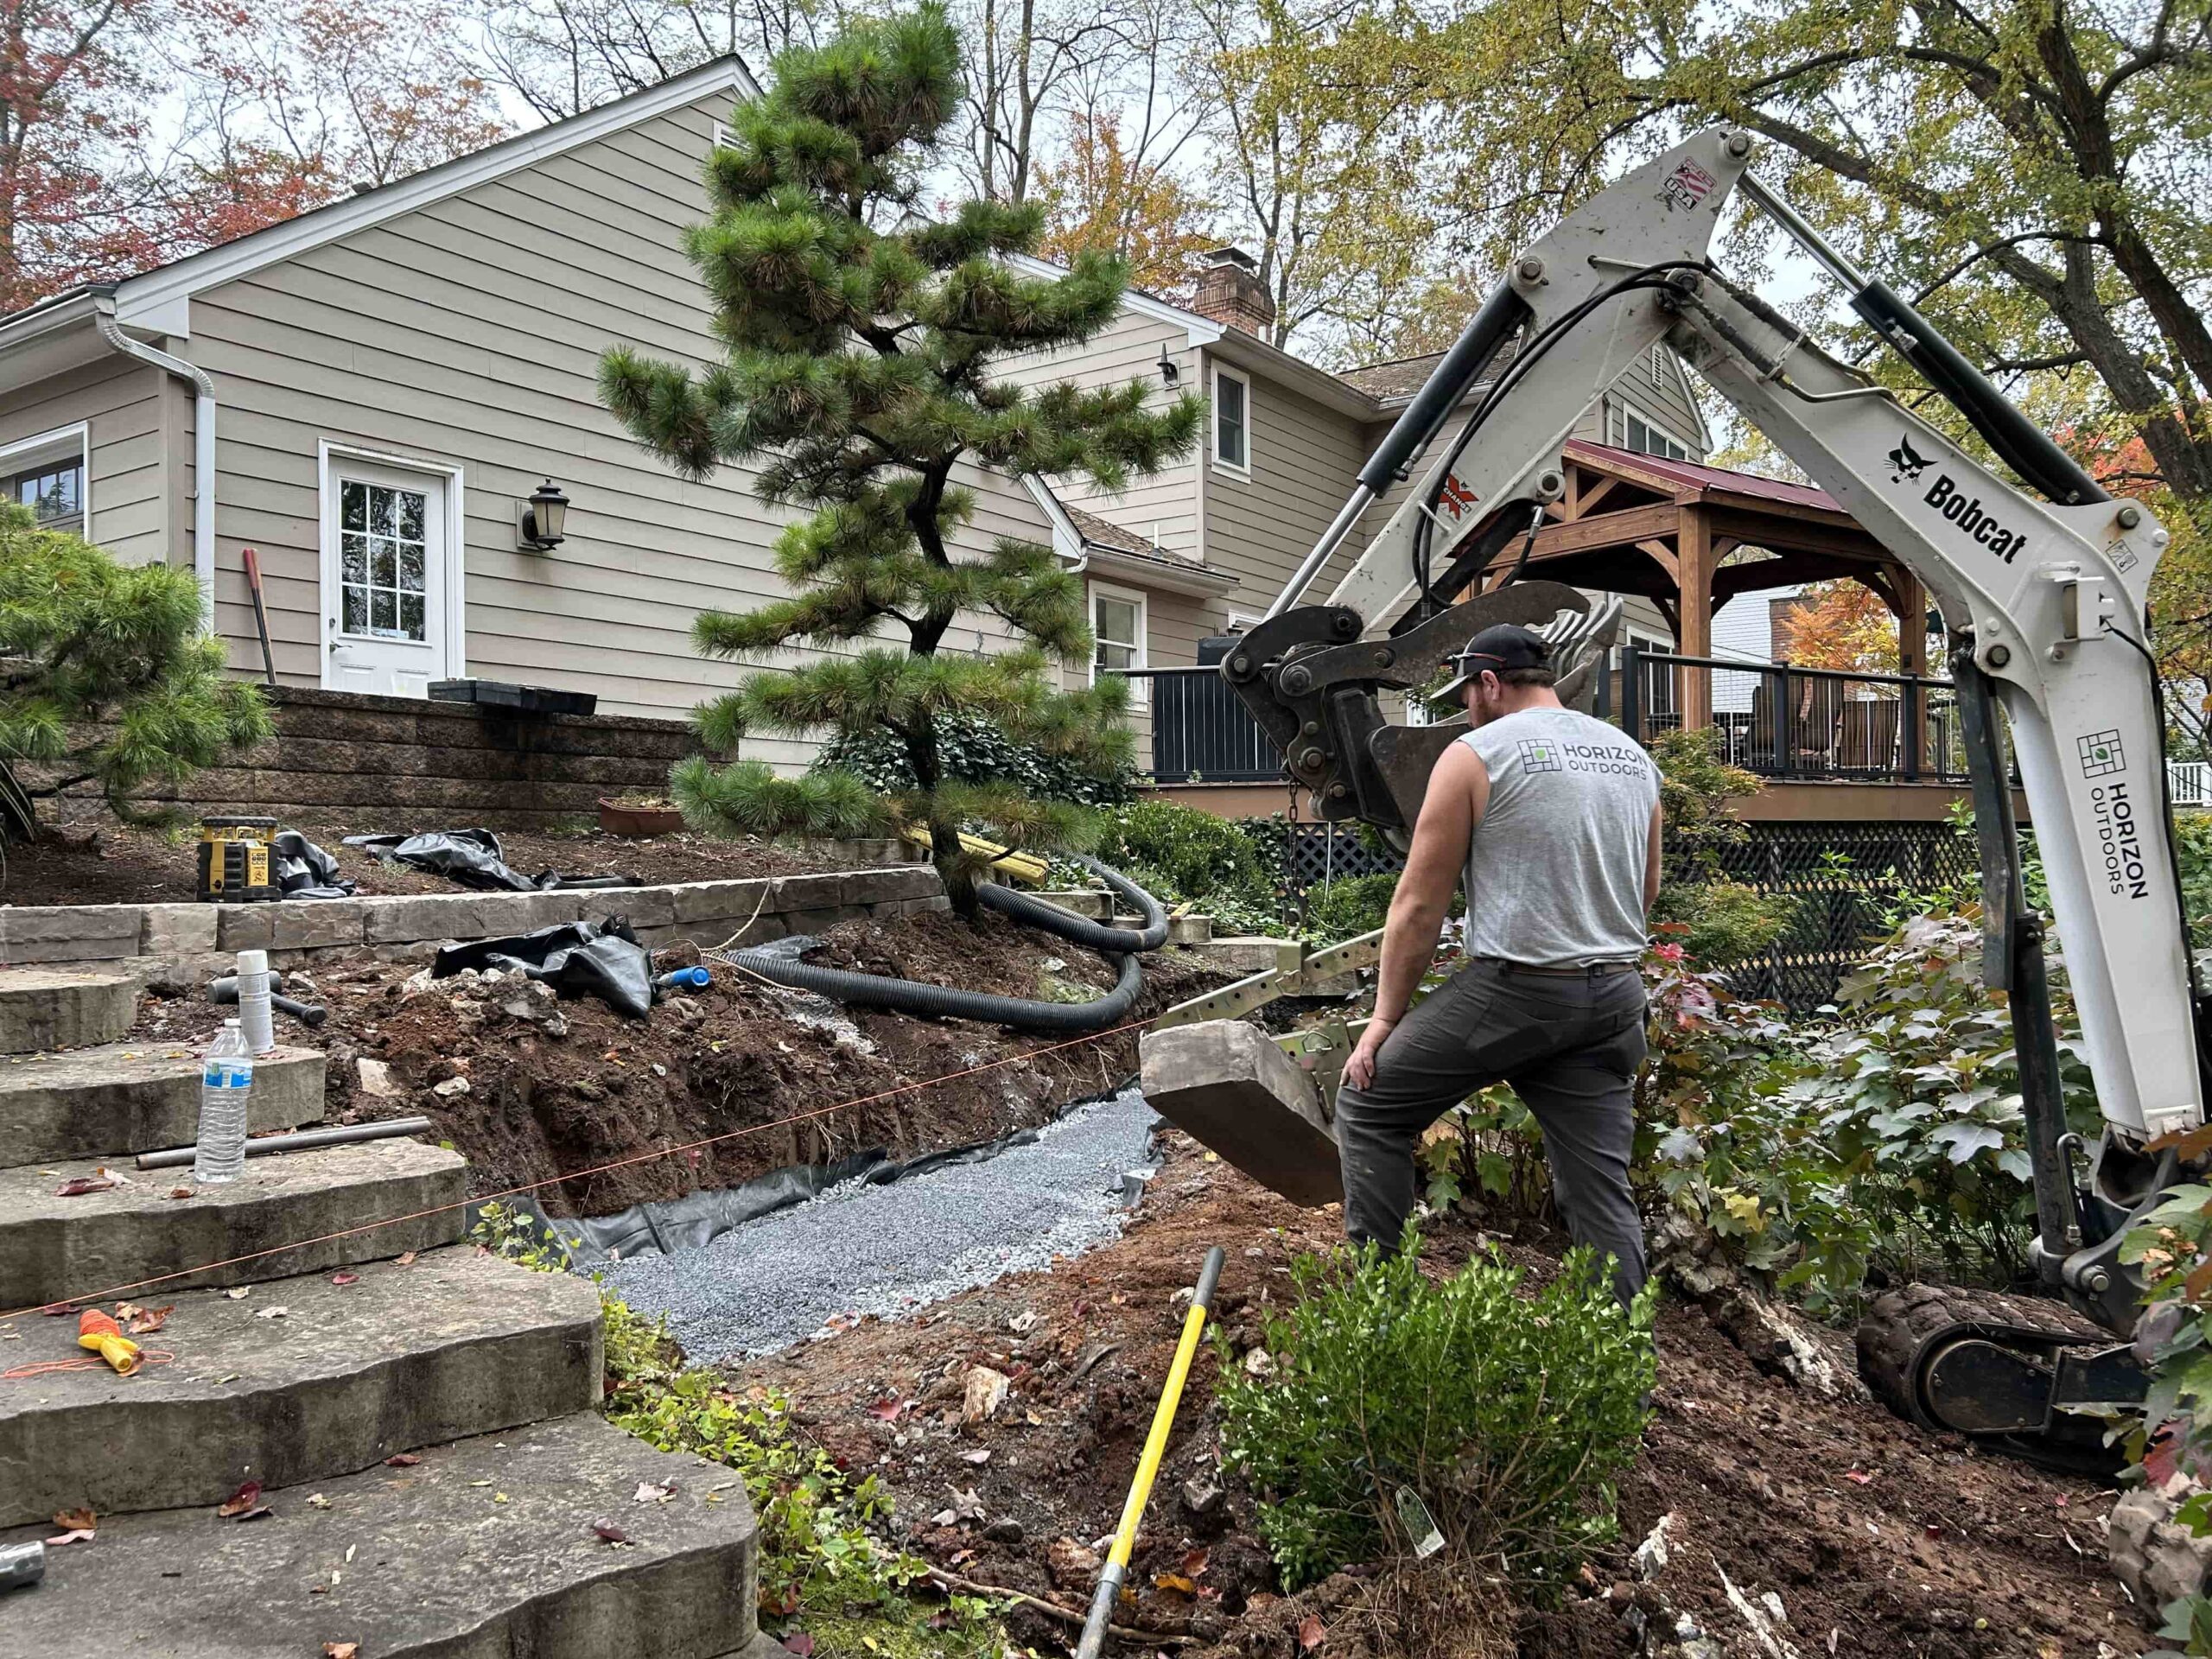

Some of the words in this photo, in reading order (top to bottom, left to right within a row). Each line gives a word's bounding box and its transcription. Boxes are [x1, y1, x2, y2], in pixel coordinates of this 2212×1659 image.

[1666, 179, 1694, 208] USA
[1443, 487, 1471, 512] CHANGE
[1923, 474, 2027, 564] Bobcat
[1563, 743, 1649, 767] HORIZON
[1568, 760, 1647, 780] OUTDOORS
[2091, 787, 2124, 894] OUTDOORS
[2108, 783, 2149, 899] HORIZON
